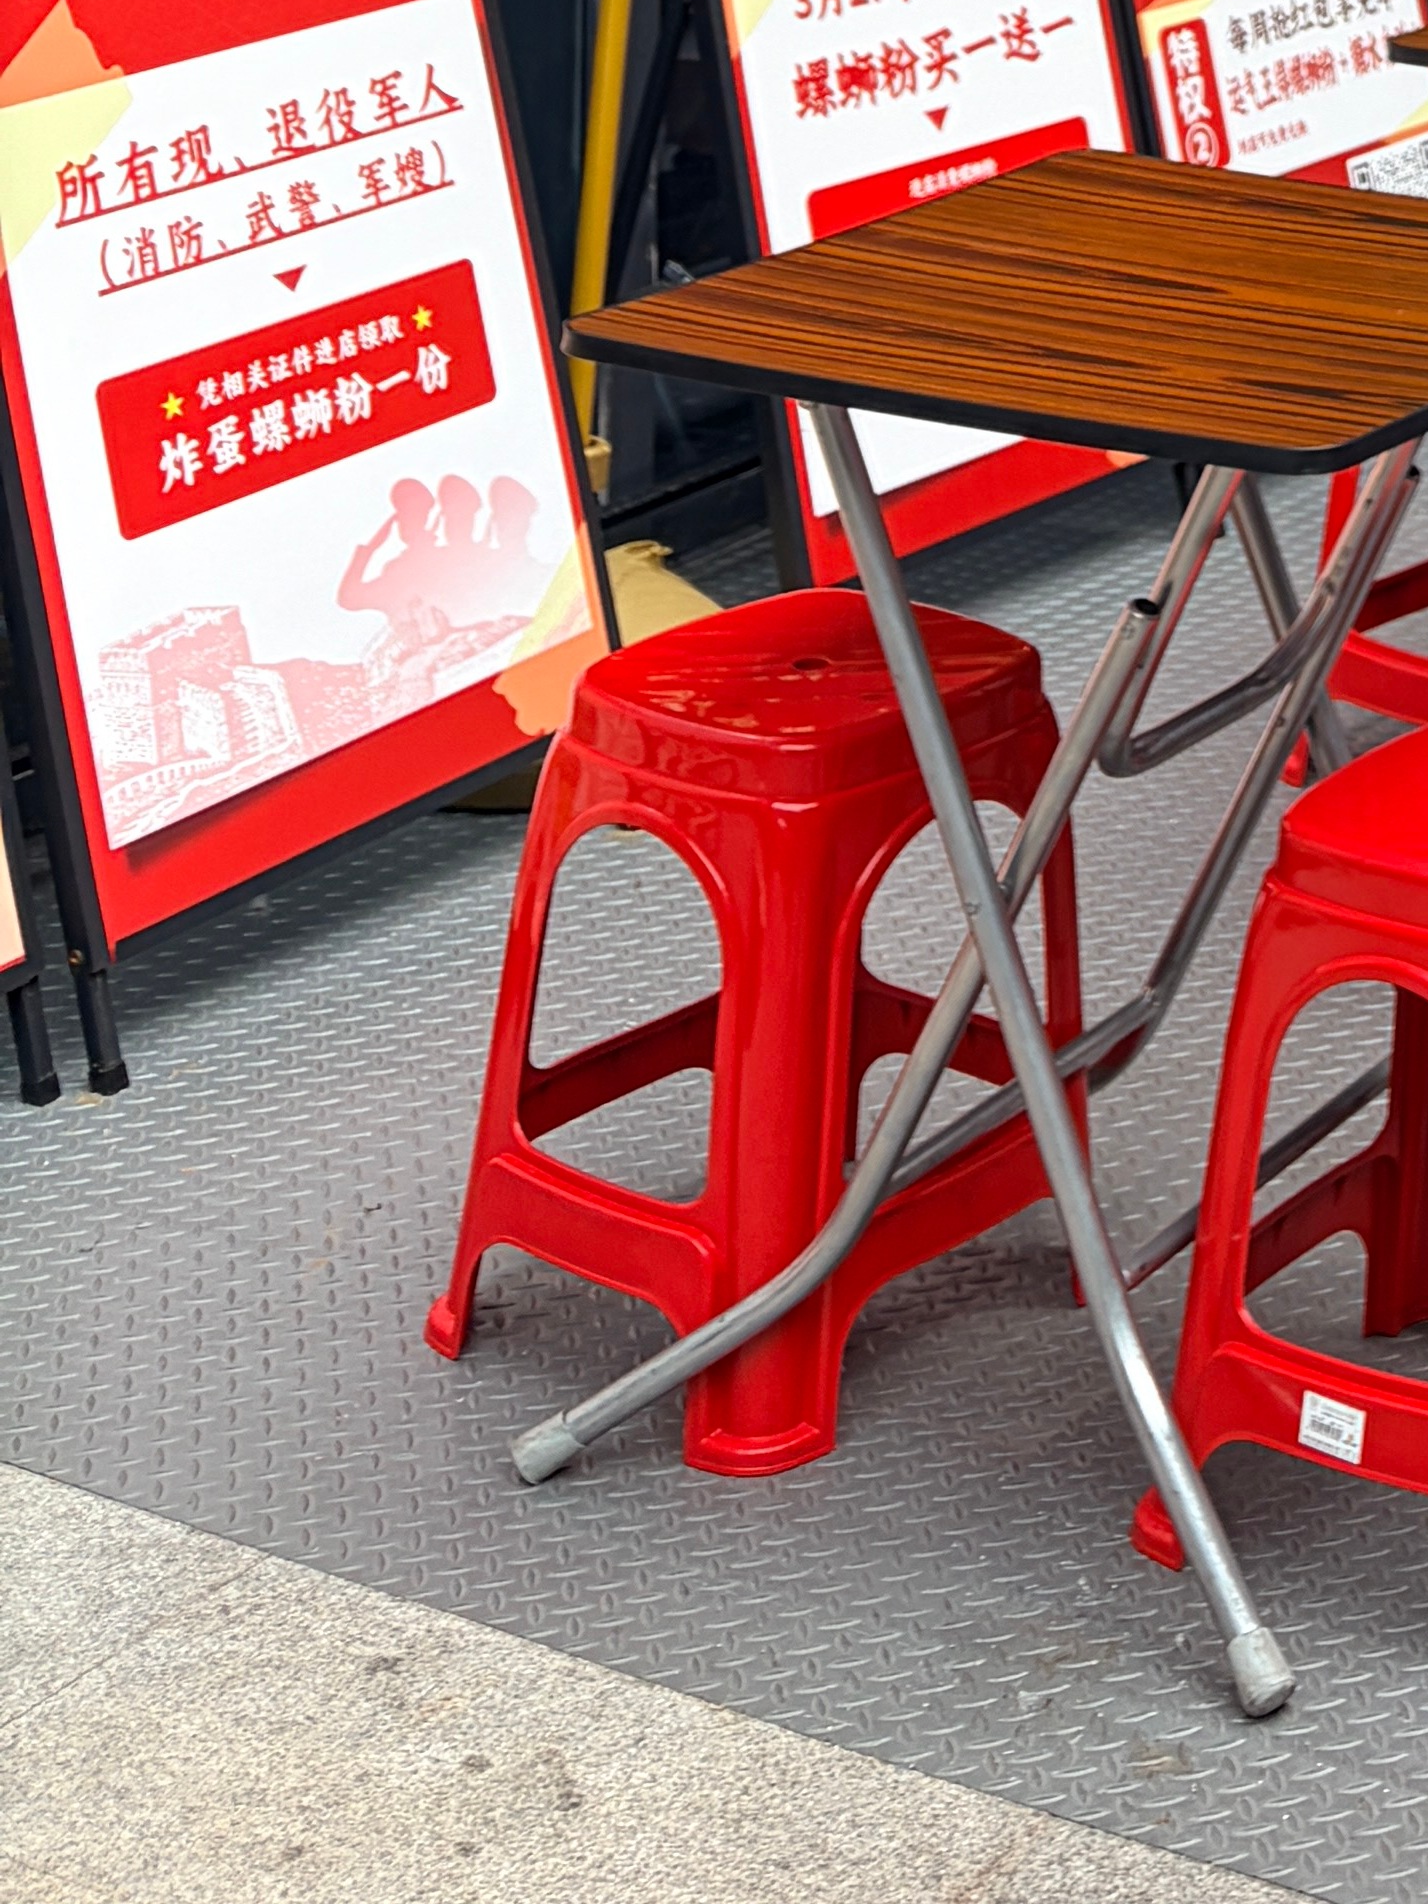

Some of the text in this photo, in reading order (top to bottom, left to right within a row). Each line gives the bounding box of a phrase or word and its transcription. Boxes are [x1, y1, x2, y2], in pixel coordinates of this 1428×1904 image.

[793, 6, 1076, 120] 螺蛳粉买一送一
[55, 63, 463, 225] 所有现、退役军人
[157, 342, 452, 492] 炸蛋螺蛳粉一份
[195, 315, 404, 411] 凭相关证件进店领取
